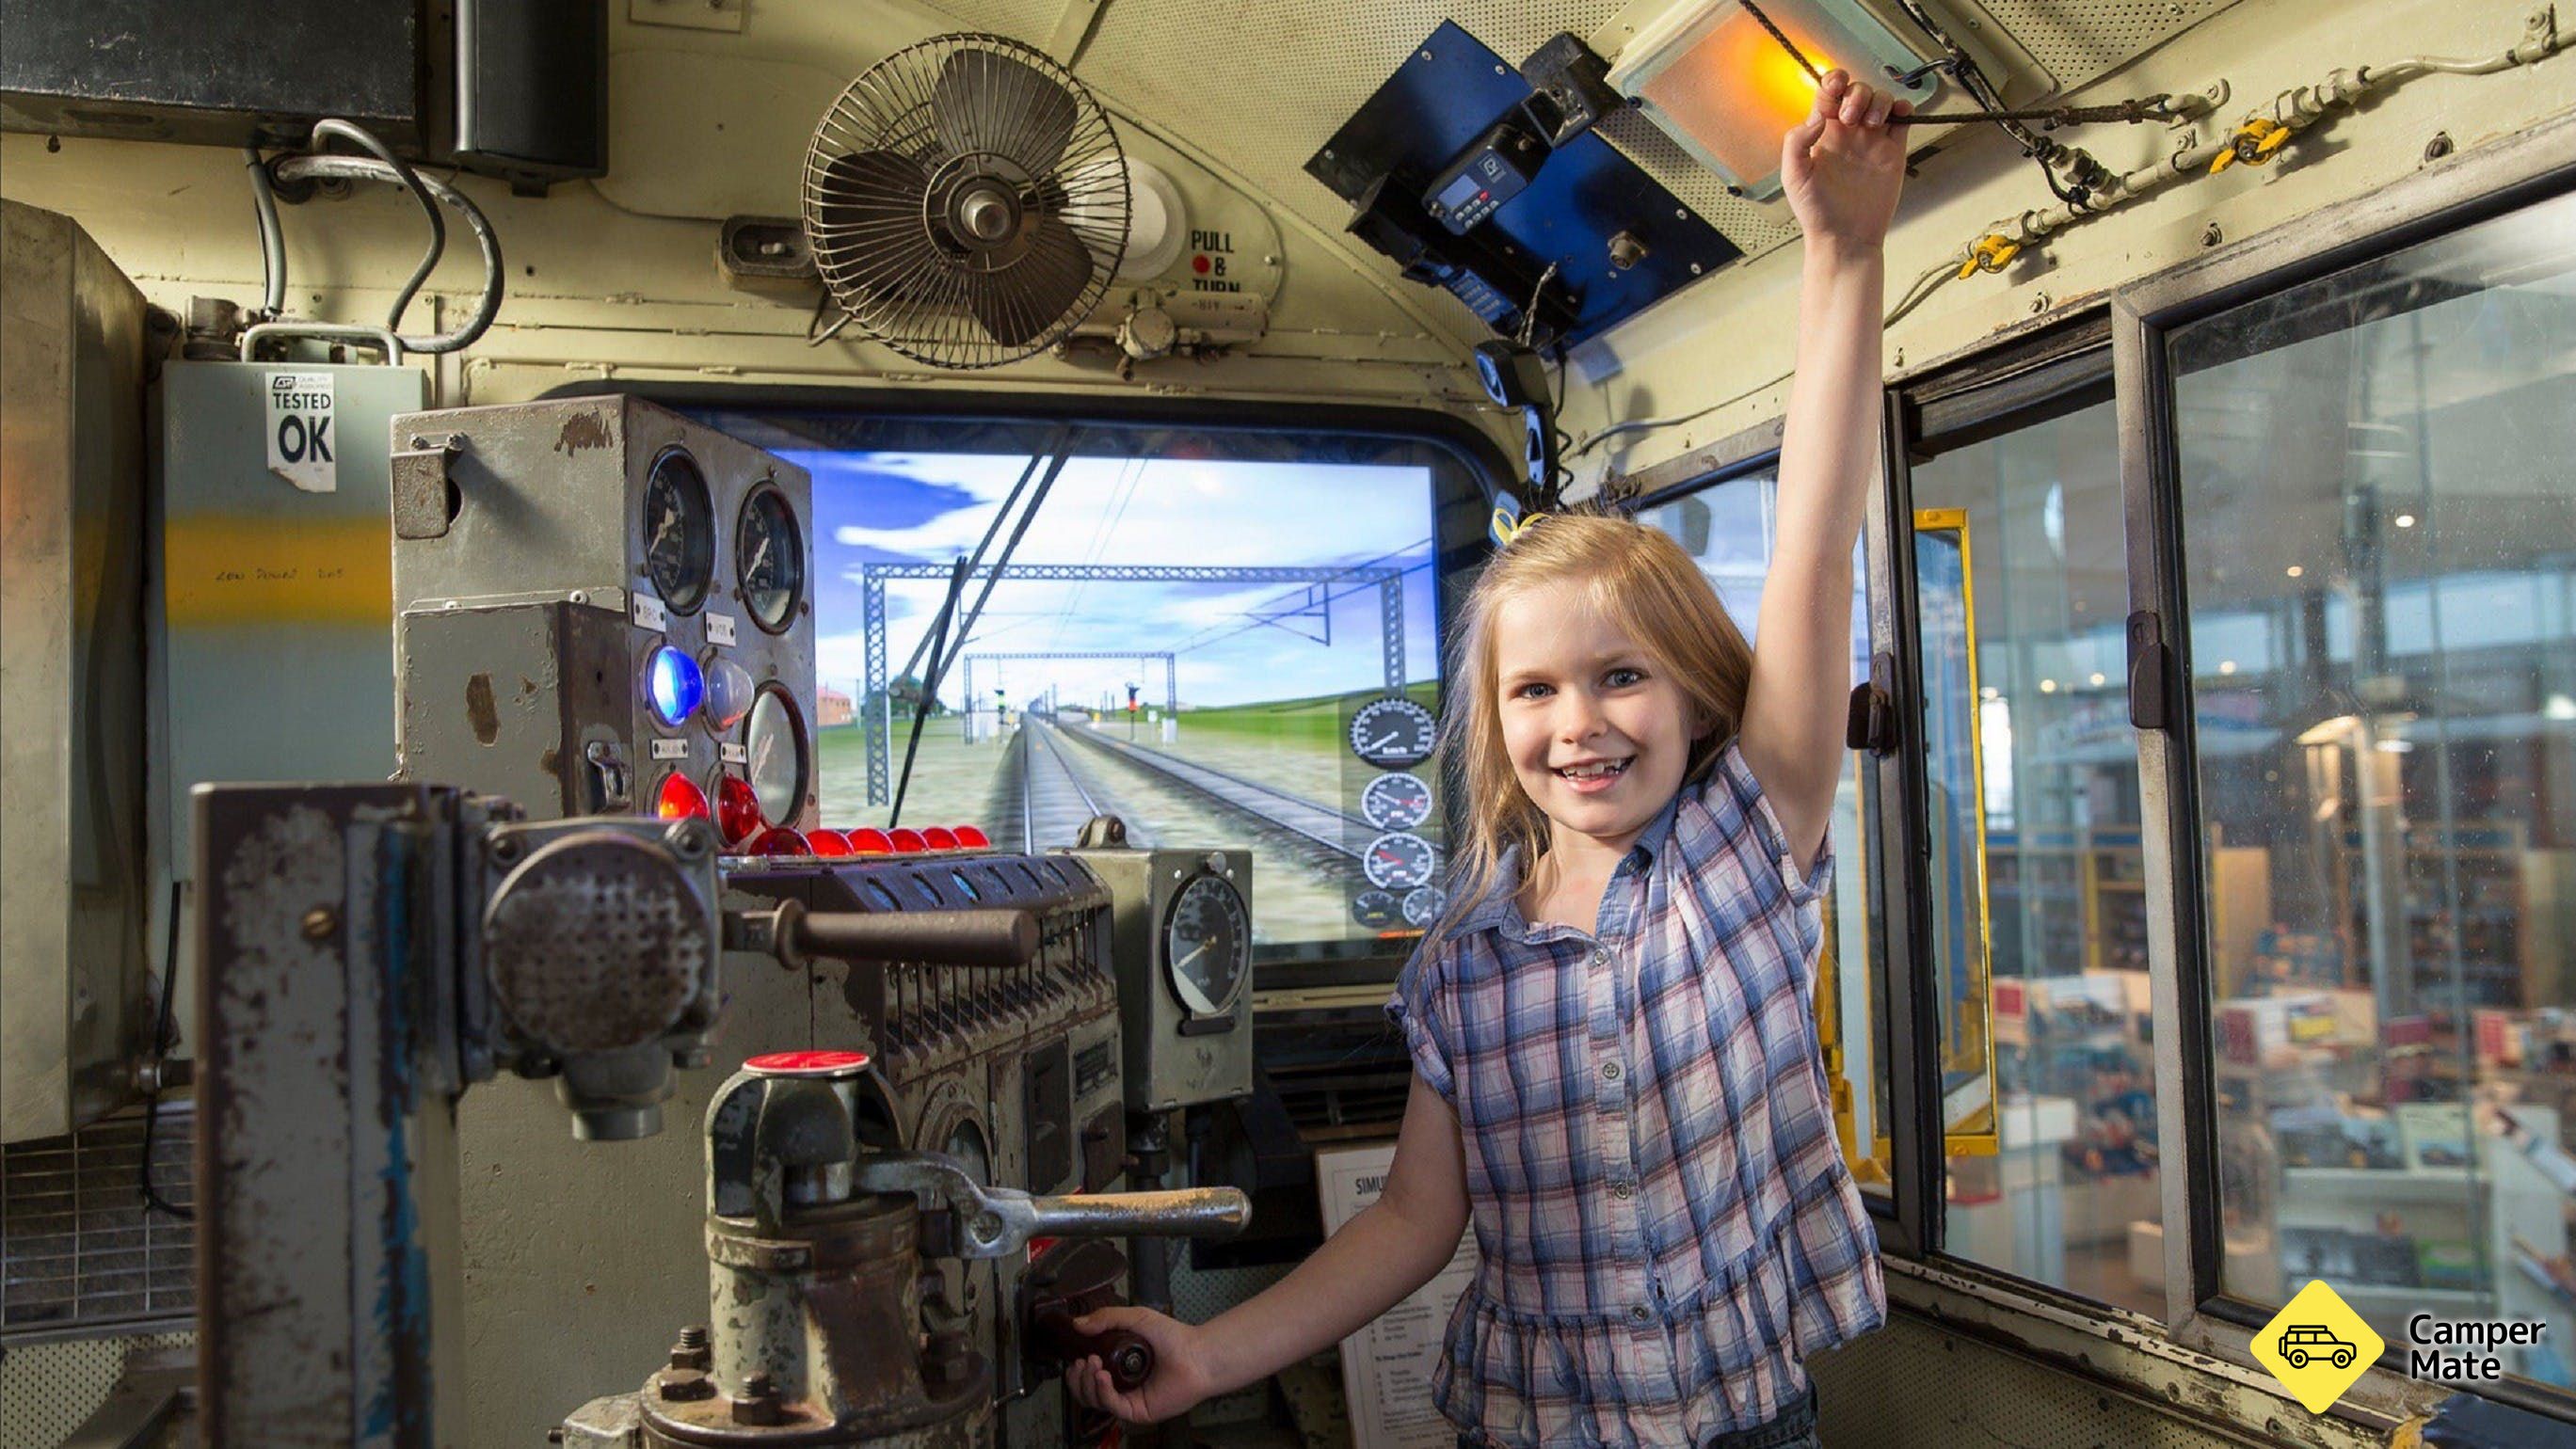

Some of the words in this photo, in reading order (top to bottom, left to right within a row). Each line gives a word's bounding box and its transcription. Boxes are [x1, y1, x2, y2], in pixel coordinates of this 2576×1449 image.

[1192, 230, 1234, 253] PULL
[1214, 257, 1226, 277] &
[272, 392, 331, 409] TESTED
[279, 415, 333, 463] OK
